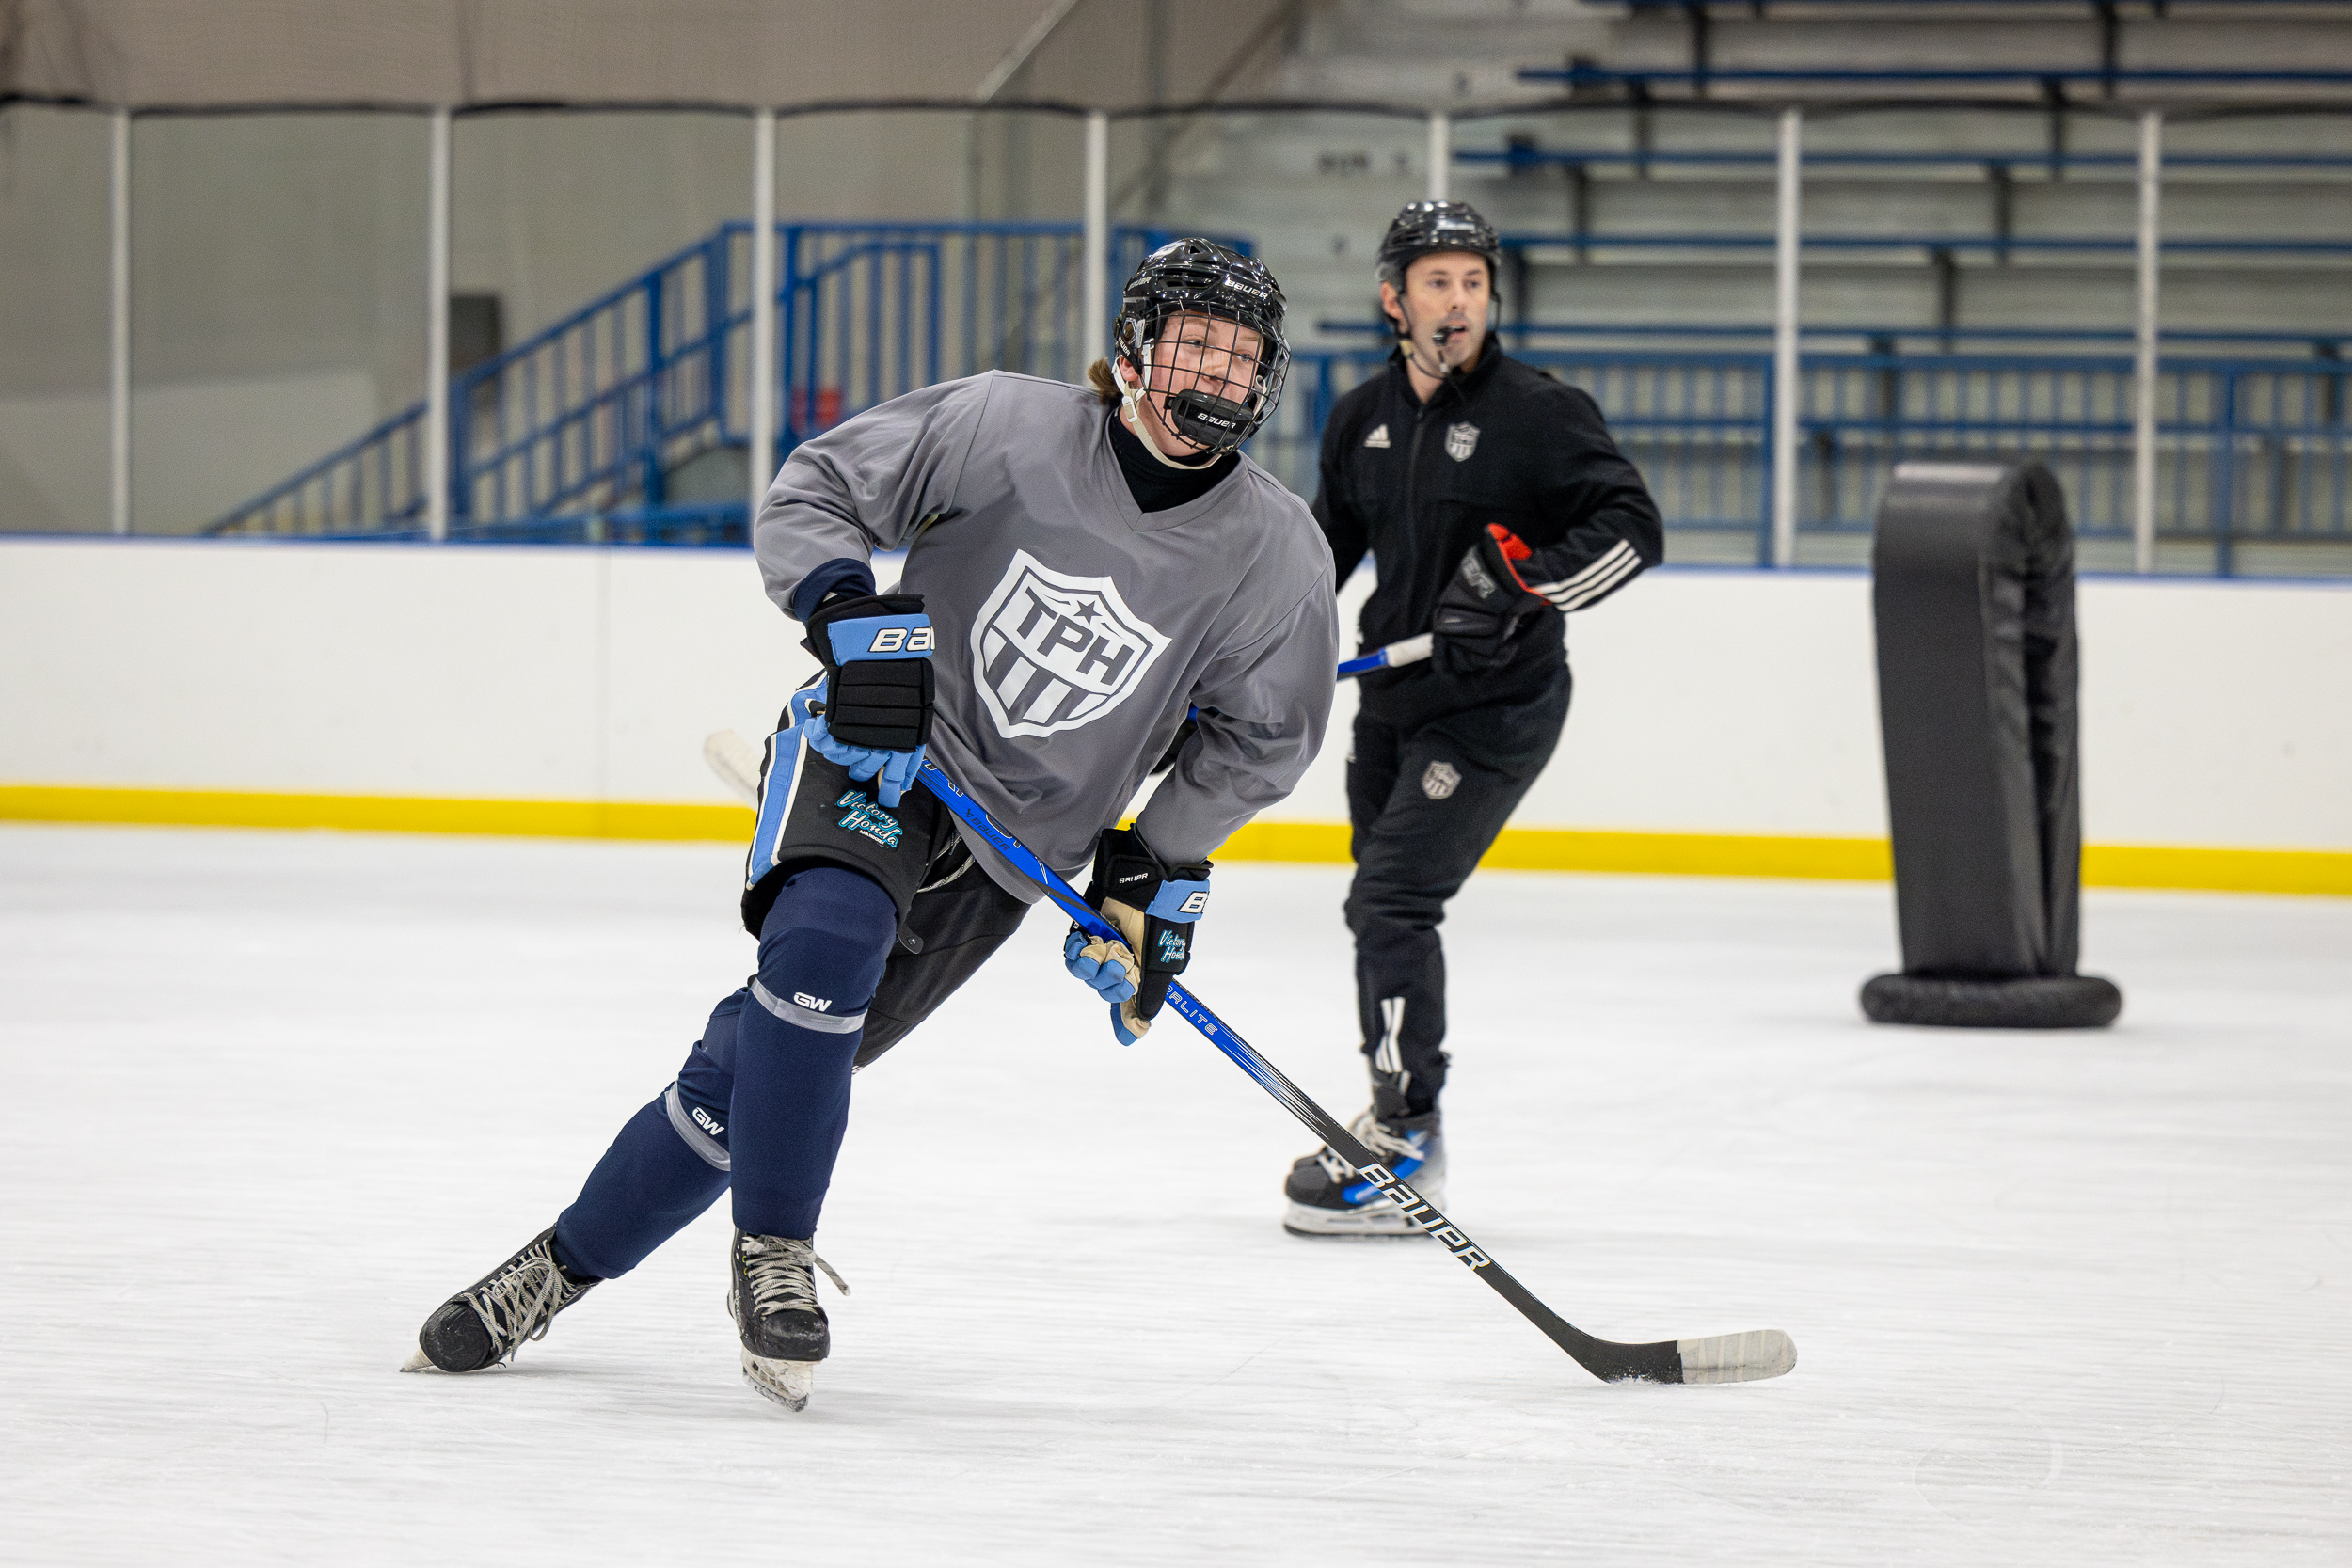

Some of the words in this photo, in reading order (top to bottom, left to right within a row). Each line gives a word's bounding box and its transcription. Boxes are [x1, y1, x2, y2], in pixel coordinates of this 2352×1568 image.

[1223, 277, 1269, 300] BAUER
[1016, 585, 1136, 687] TPH
[837, 789, 899, 831] Victory
[839, 809, 903, 848] Honda
[970, 816, 1010, 851] BAUER
[793, 991, 833, 1012] GW
[691, 1106, 725, 1136] GW
